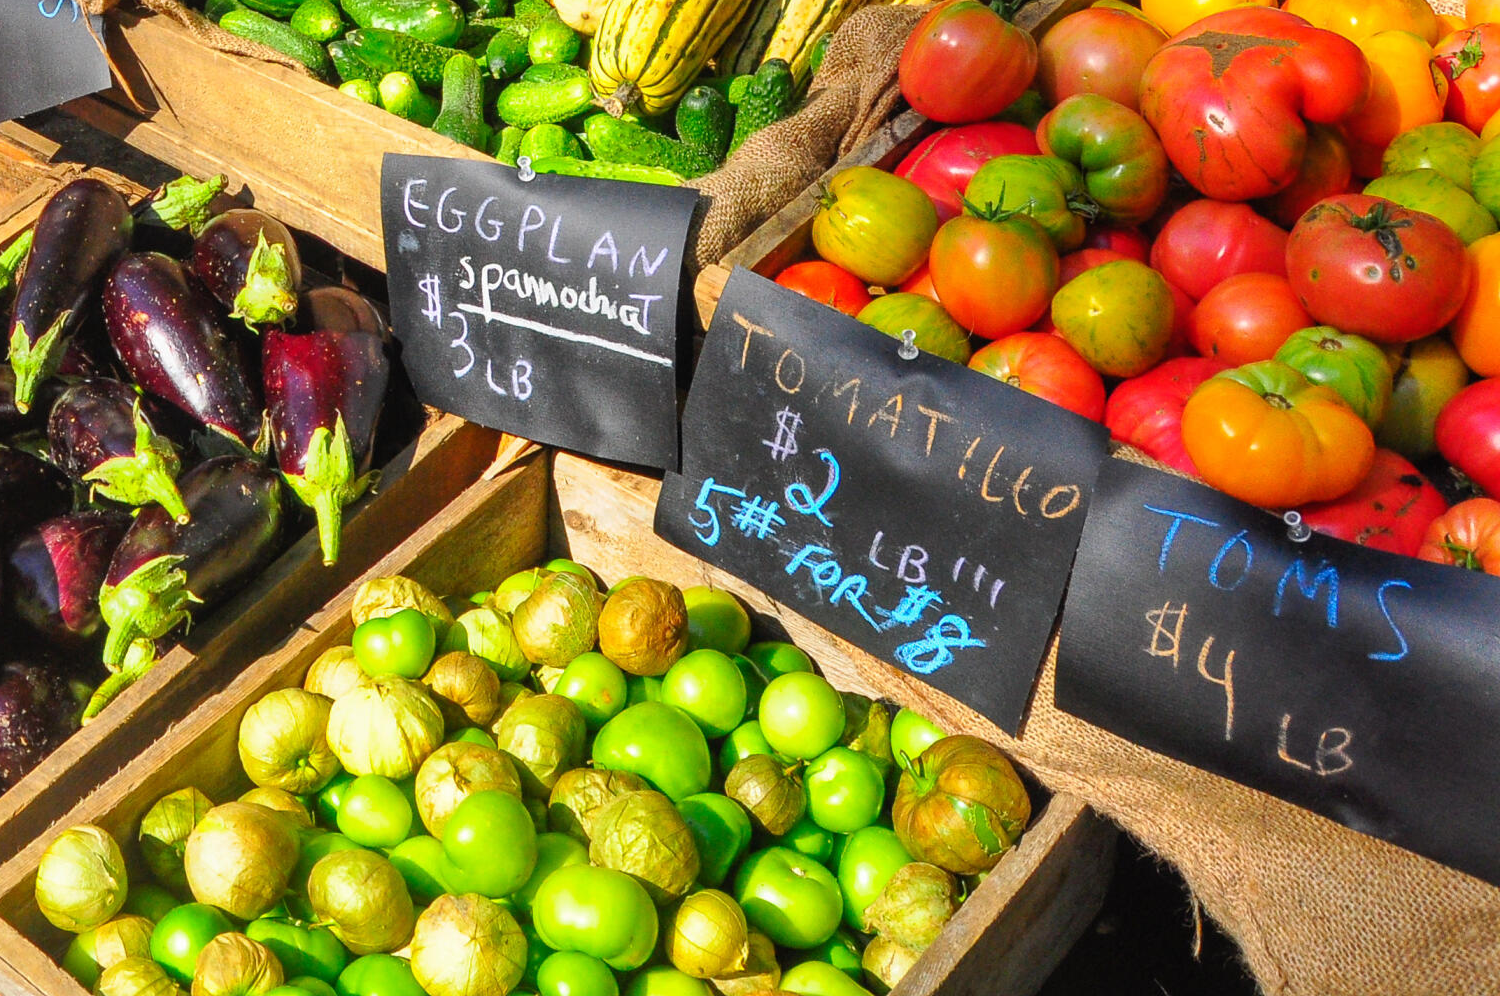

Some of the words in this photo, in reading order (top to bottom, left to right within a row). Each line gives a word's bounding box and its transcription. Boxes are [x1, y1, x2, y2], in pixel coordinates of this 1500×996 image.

[485, 358, 534, 401] LB
[731, 311, 1082, 520] TOMATILLO
[784, 544, 884, 635] FOR
[868, 530, 930, 584] LB
[1142, 504, 1413, 662] TOMS
[1277, 713, 1354, 776] LB
